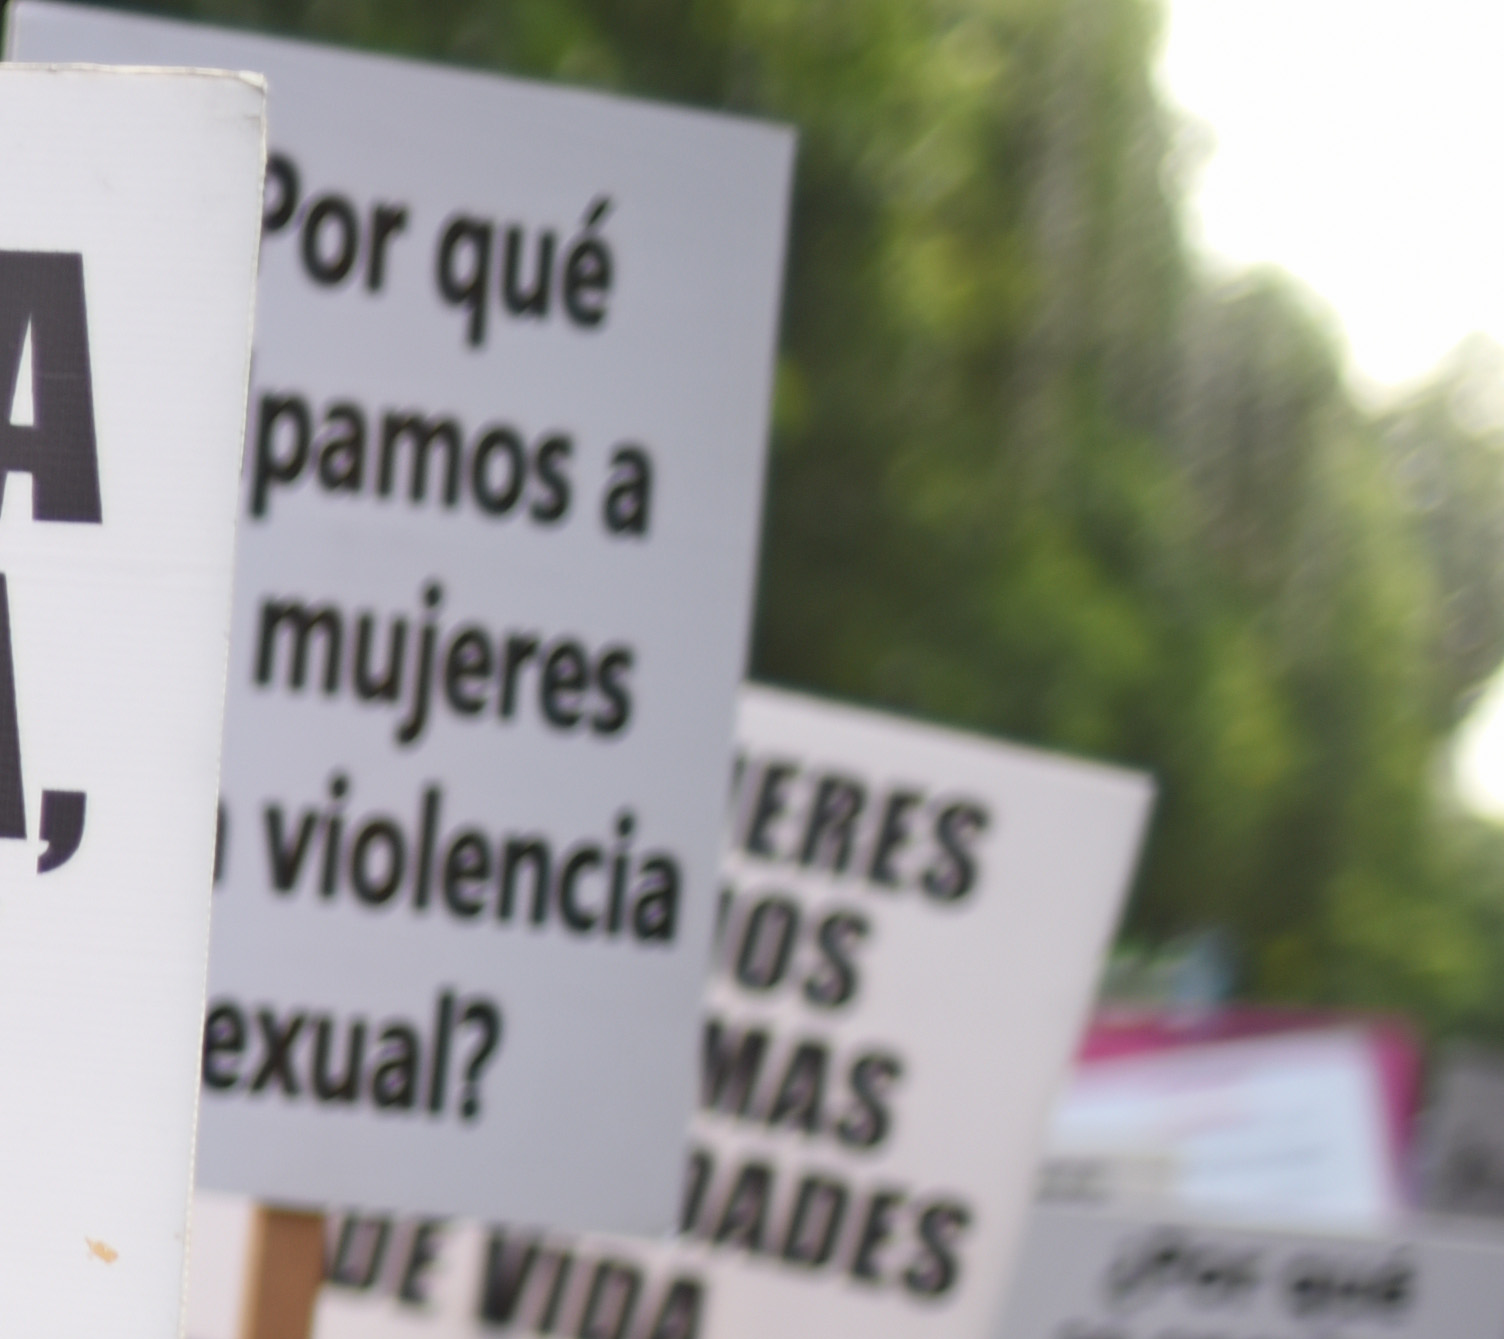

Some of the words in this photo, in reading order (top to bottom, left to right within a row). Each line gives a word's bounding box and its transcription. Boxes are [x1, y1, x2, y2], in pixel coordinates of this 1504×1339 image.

[432, 192, 616, 353] qué
[600, 443, 657, 541] a
[252, 575, 635, 753] mujeres
[261, 770, 684, 946] violencia
[732, 748, 994, 907] ERES
[714, 884, 873, 1011] OS
